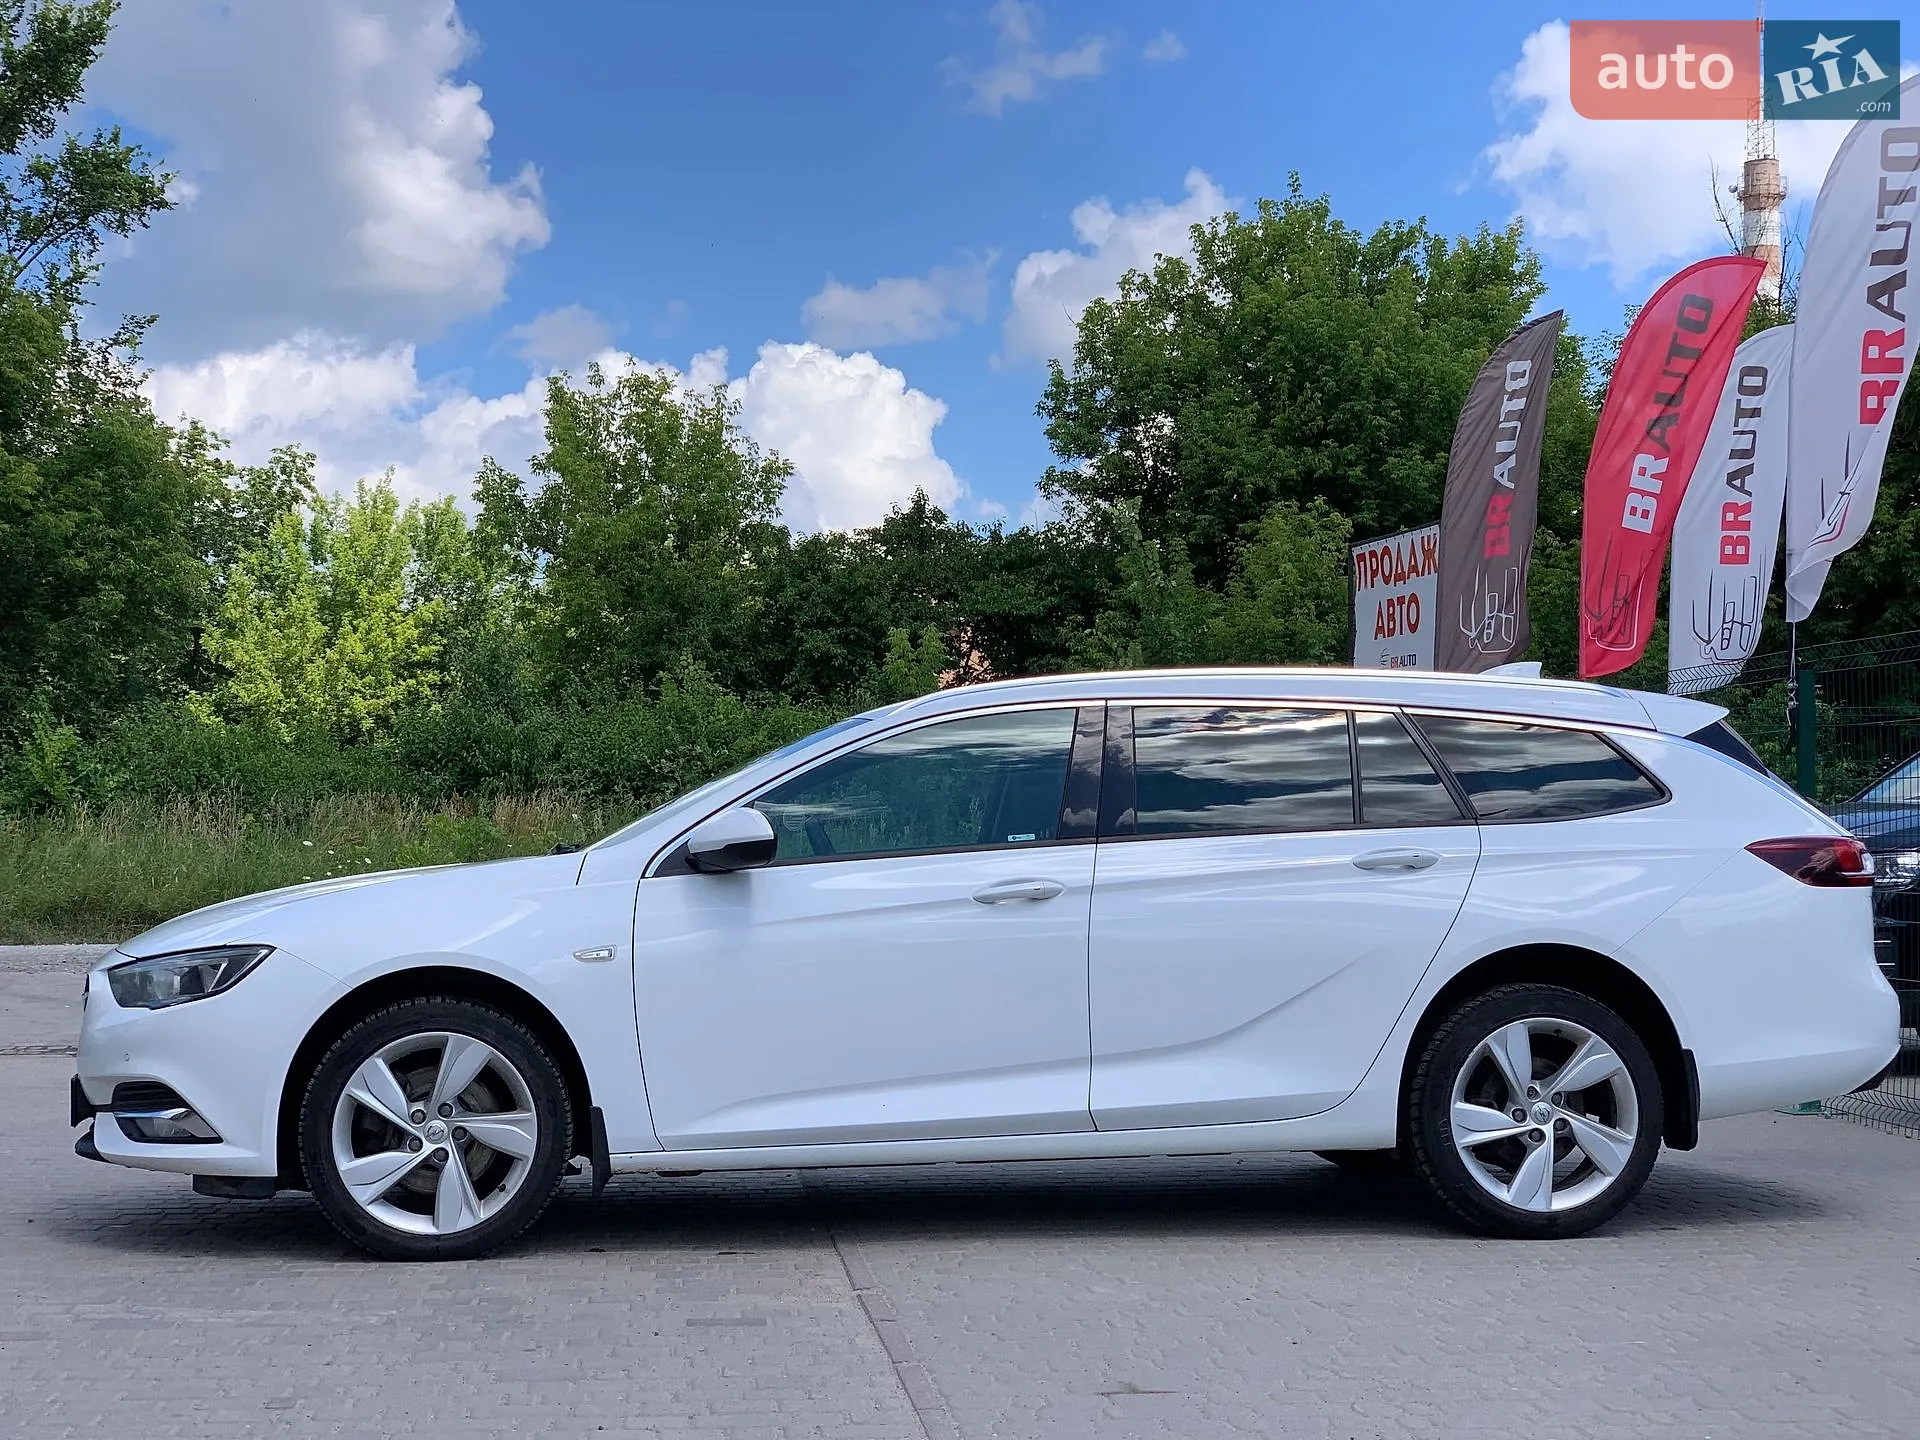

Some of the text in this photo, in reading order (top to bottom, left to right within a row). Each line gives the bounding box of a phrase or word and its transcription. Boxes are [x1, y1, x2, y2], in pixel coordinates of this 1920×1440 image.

[1621, 293, 1714, 534] BRAUTO
[1719, 365, 1768, 566] BRAUTO
[1355, 533, 1437, 592] ПРОДАЖ
[1374, 592, 1420, 640] АВТО
